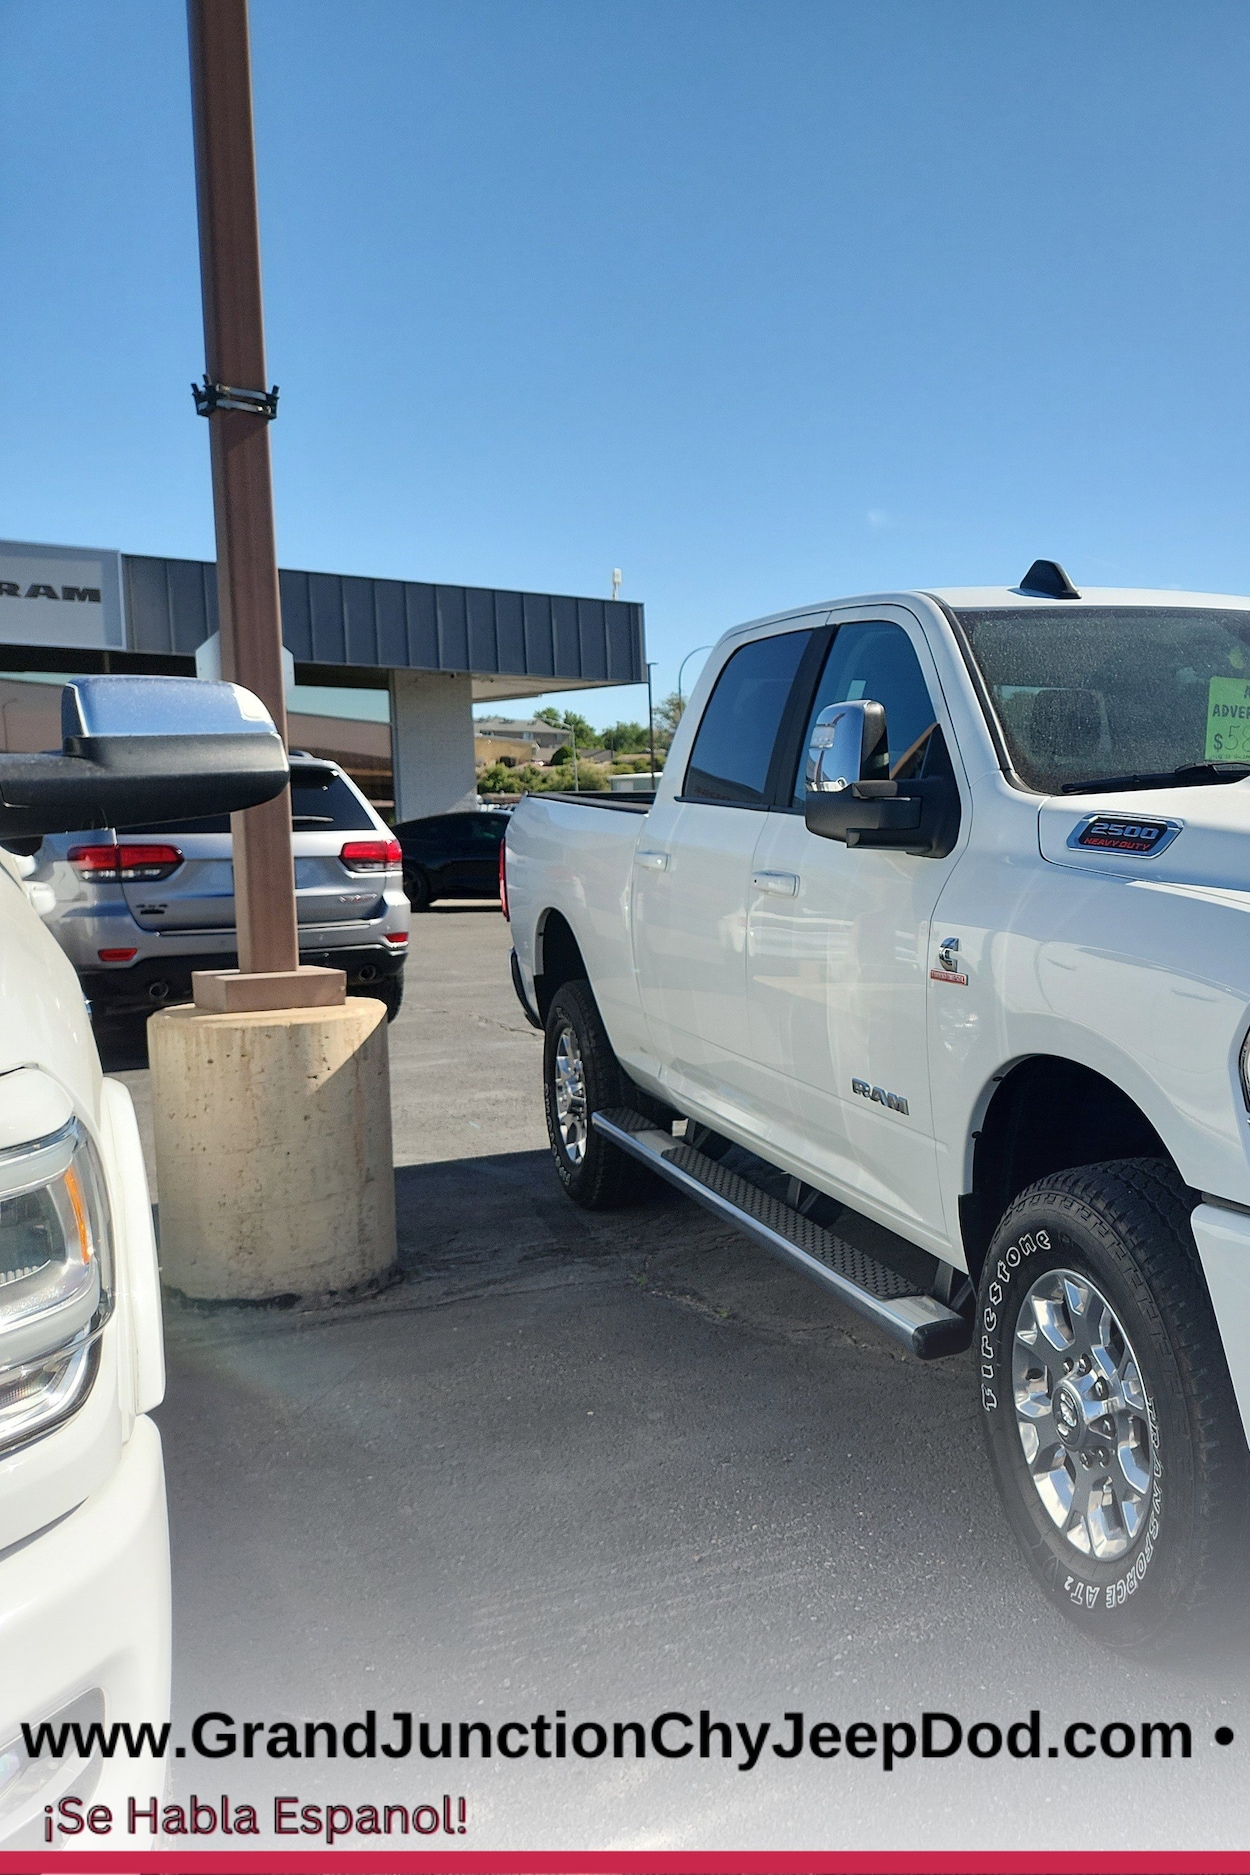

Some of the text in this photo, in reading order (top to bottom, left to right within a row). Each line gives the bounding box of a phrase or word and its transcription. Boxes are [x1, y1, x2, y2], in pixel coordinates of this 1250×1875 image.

[0, 581, 101, 604] RAM
[1091, 822, 1160, 839] 2500
[1084, 837, 1151, 851] HEAVY DUTY
[851, 1077, 910, 1116] RAM
